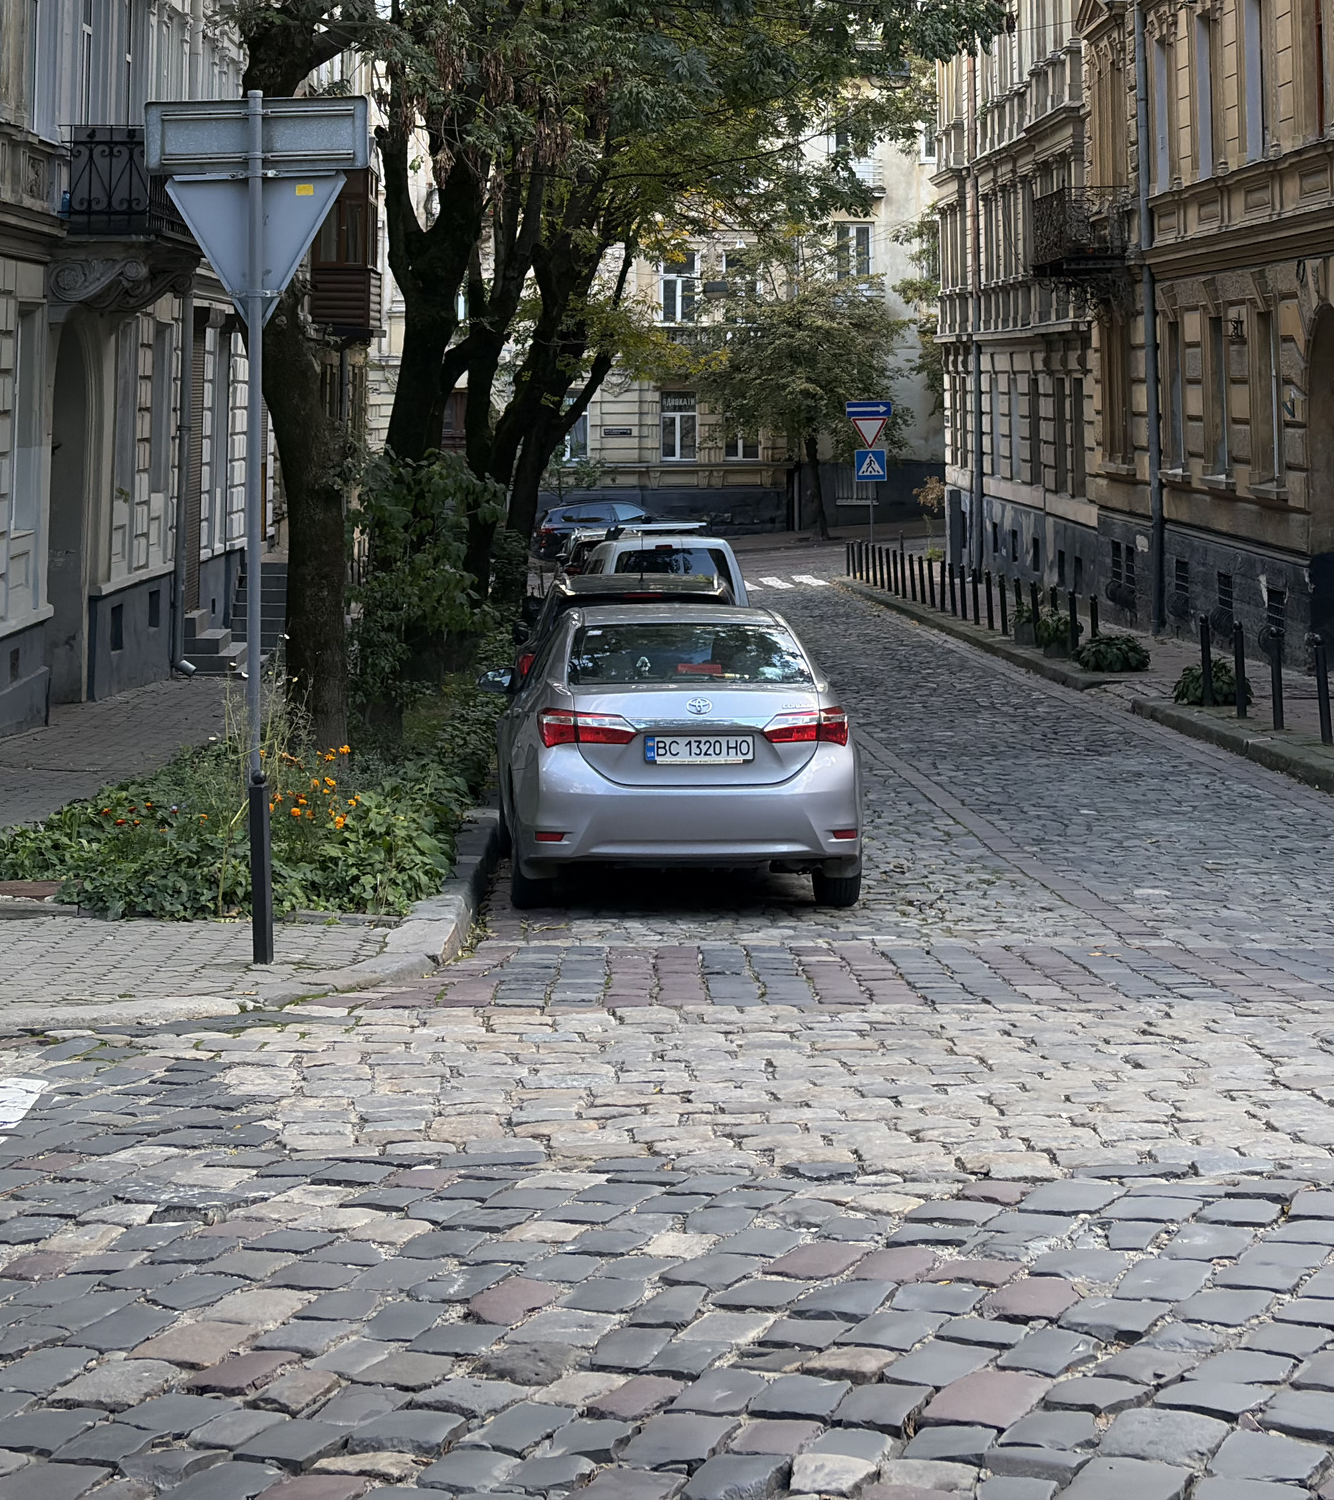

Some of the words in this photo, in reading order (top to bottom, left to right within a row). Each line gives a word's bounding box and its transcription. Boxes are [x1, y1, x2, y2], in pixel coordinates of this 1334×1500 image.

[656, 740, 680, 757] BC
[684, 739, 723, 757] 1320
[726, 739, 751, 757] HO
